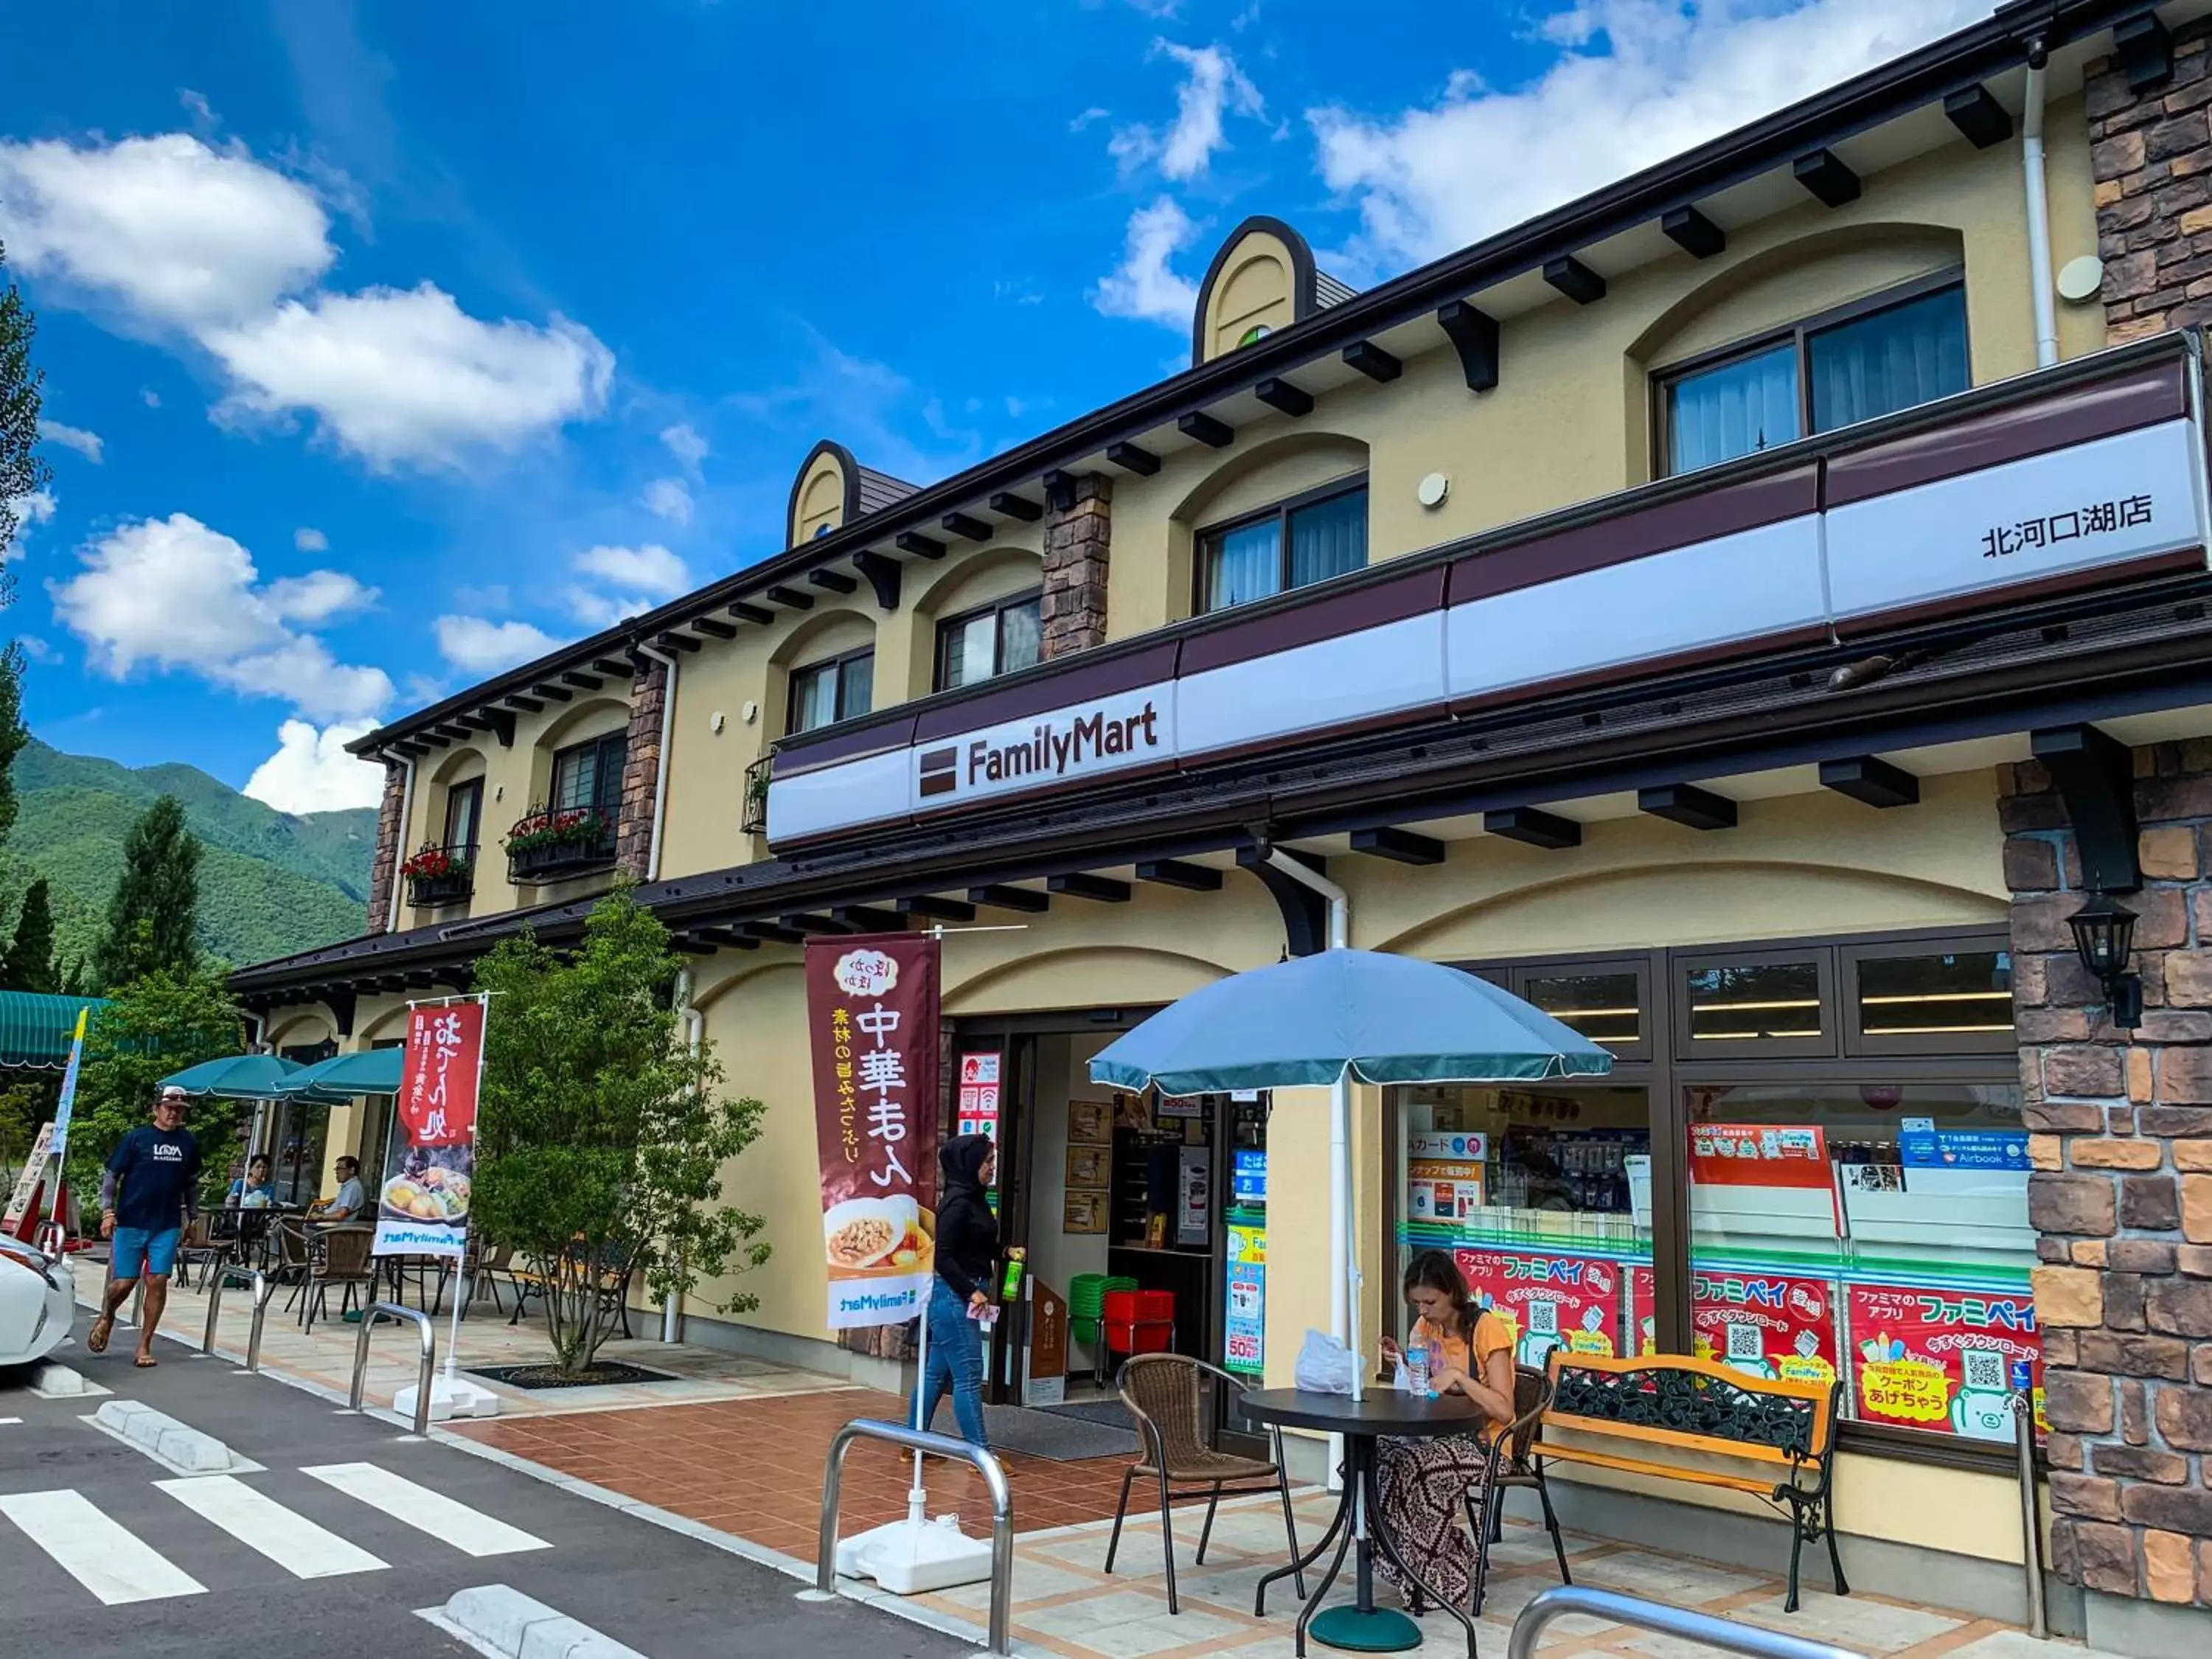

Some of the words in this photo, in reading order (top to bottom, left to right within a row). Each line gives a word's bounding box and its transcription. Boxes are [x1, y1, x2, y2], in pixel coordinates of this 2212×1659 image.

[1981, 494, 2152, 558] 北河口湖店
[969, 702, 1158, 785] FamilyMart
[1959, 1152, 2003, 1164] Airbook
[1461, 1253, 1501, 1266] ファミマの
[1469, 1266, 1493, 1276] アプリ
[1502, 1256, 1585, 1285] ファミペイ
[1693, 1276, 1787, 1309] ファミペイ
[1857, 1292, 1916, 1307] ファミマの
[1868, 1307, 1904, 1321] アプリ
[1917, 1295, 2036, 1332] ファミペイ
[1926, 1333, 2039, 1362] 今すぐダウンロード
[1879, 1375, 1929, 1391] クーポン
[1868, 1388, 1943, 1411] あげちゃう
